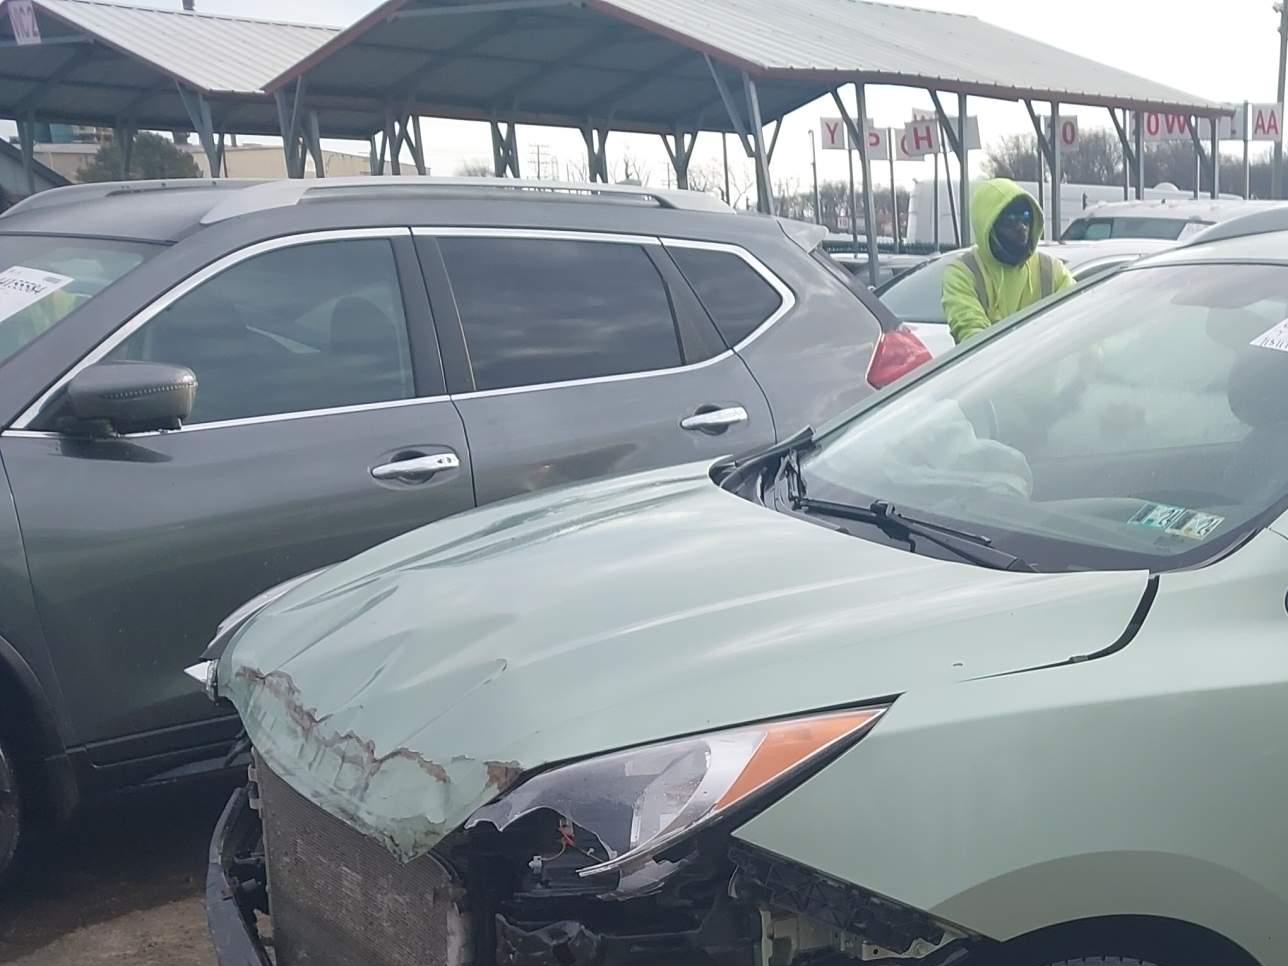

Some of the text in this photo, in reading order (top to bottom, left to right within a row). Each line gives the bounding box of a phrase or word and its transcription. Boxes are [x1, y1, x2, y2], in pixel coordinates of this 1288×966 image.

[825, 121, 839, 145] Y
[1254, 109, 1279, 135] AA
[913, 125, 933, 149] H
